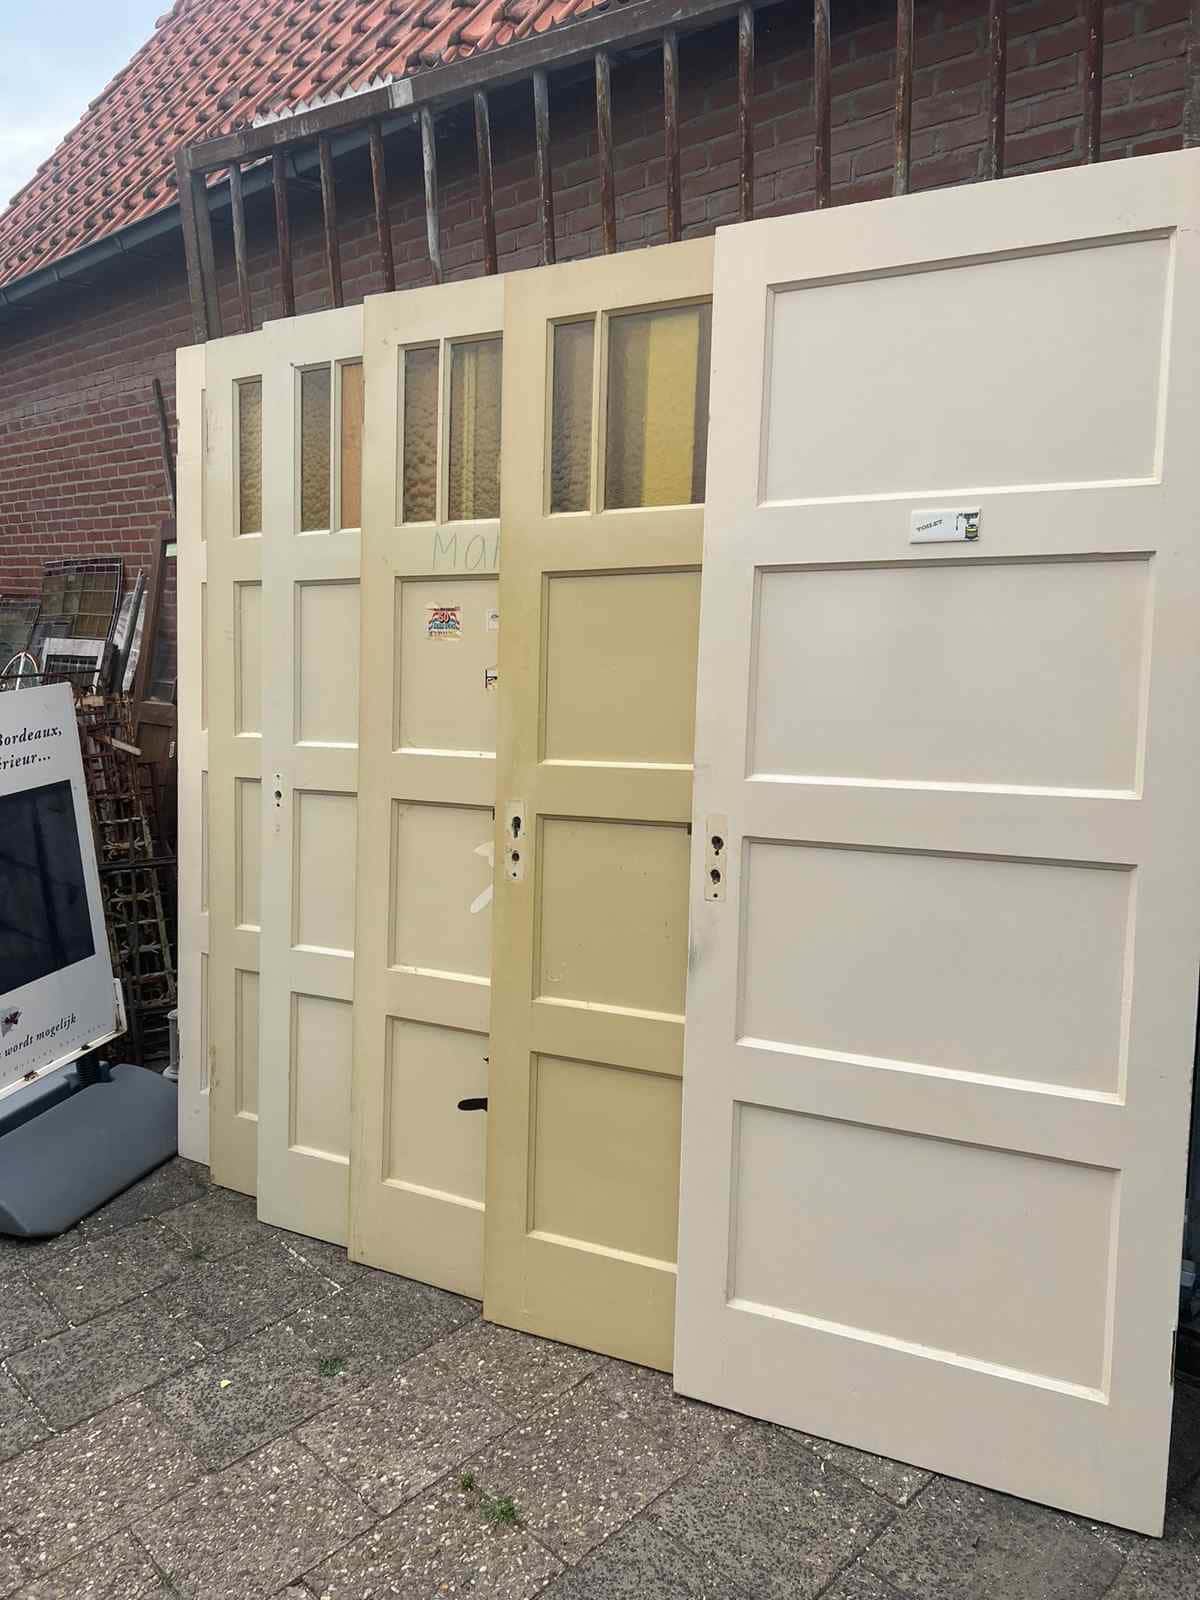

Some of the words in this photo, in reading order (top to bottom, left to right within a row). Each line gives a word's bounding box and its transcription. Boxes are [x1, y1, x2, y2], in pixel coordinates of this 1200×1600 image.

[916, 519, 943, 532] TOILET
[0, 754, 51, 770] rieur...
[4, 1034, 34, 1057] wordt
[36, 1013, 77, 1041] mogelijk
